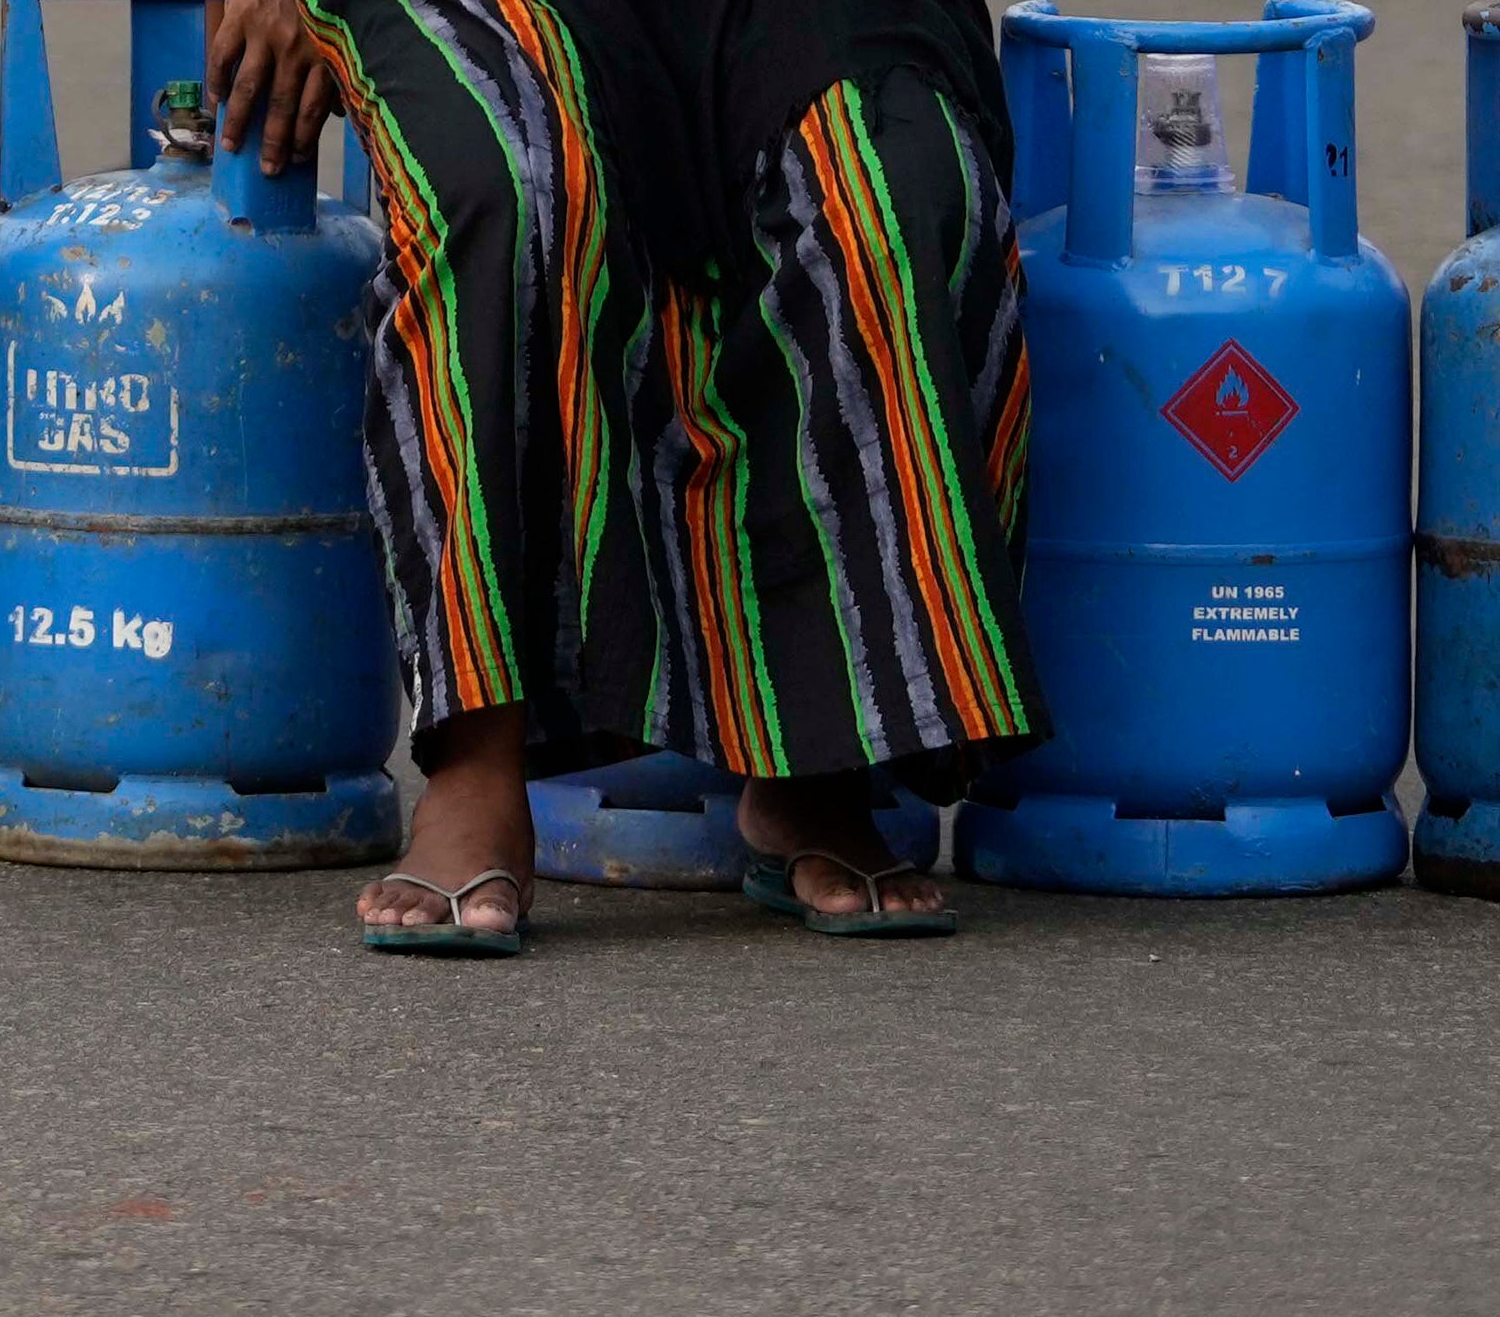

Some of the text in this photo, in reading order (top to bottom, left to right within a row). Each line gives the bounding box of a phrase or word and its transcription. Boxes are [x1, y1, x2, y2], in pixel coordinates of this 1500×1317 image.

[1211, 585, 1285, 600] UN 1965
[1193, 606, 1300, 621] EXTREMELY
[8, 604, 174, 659] 12.5 kg
[1191, 627, 1301, 642] FLAMMABLE
